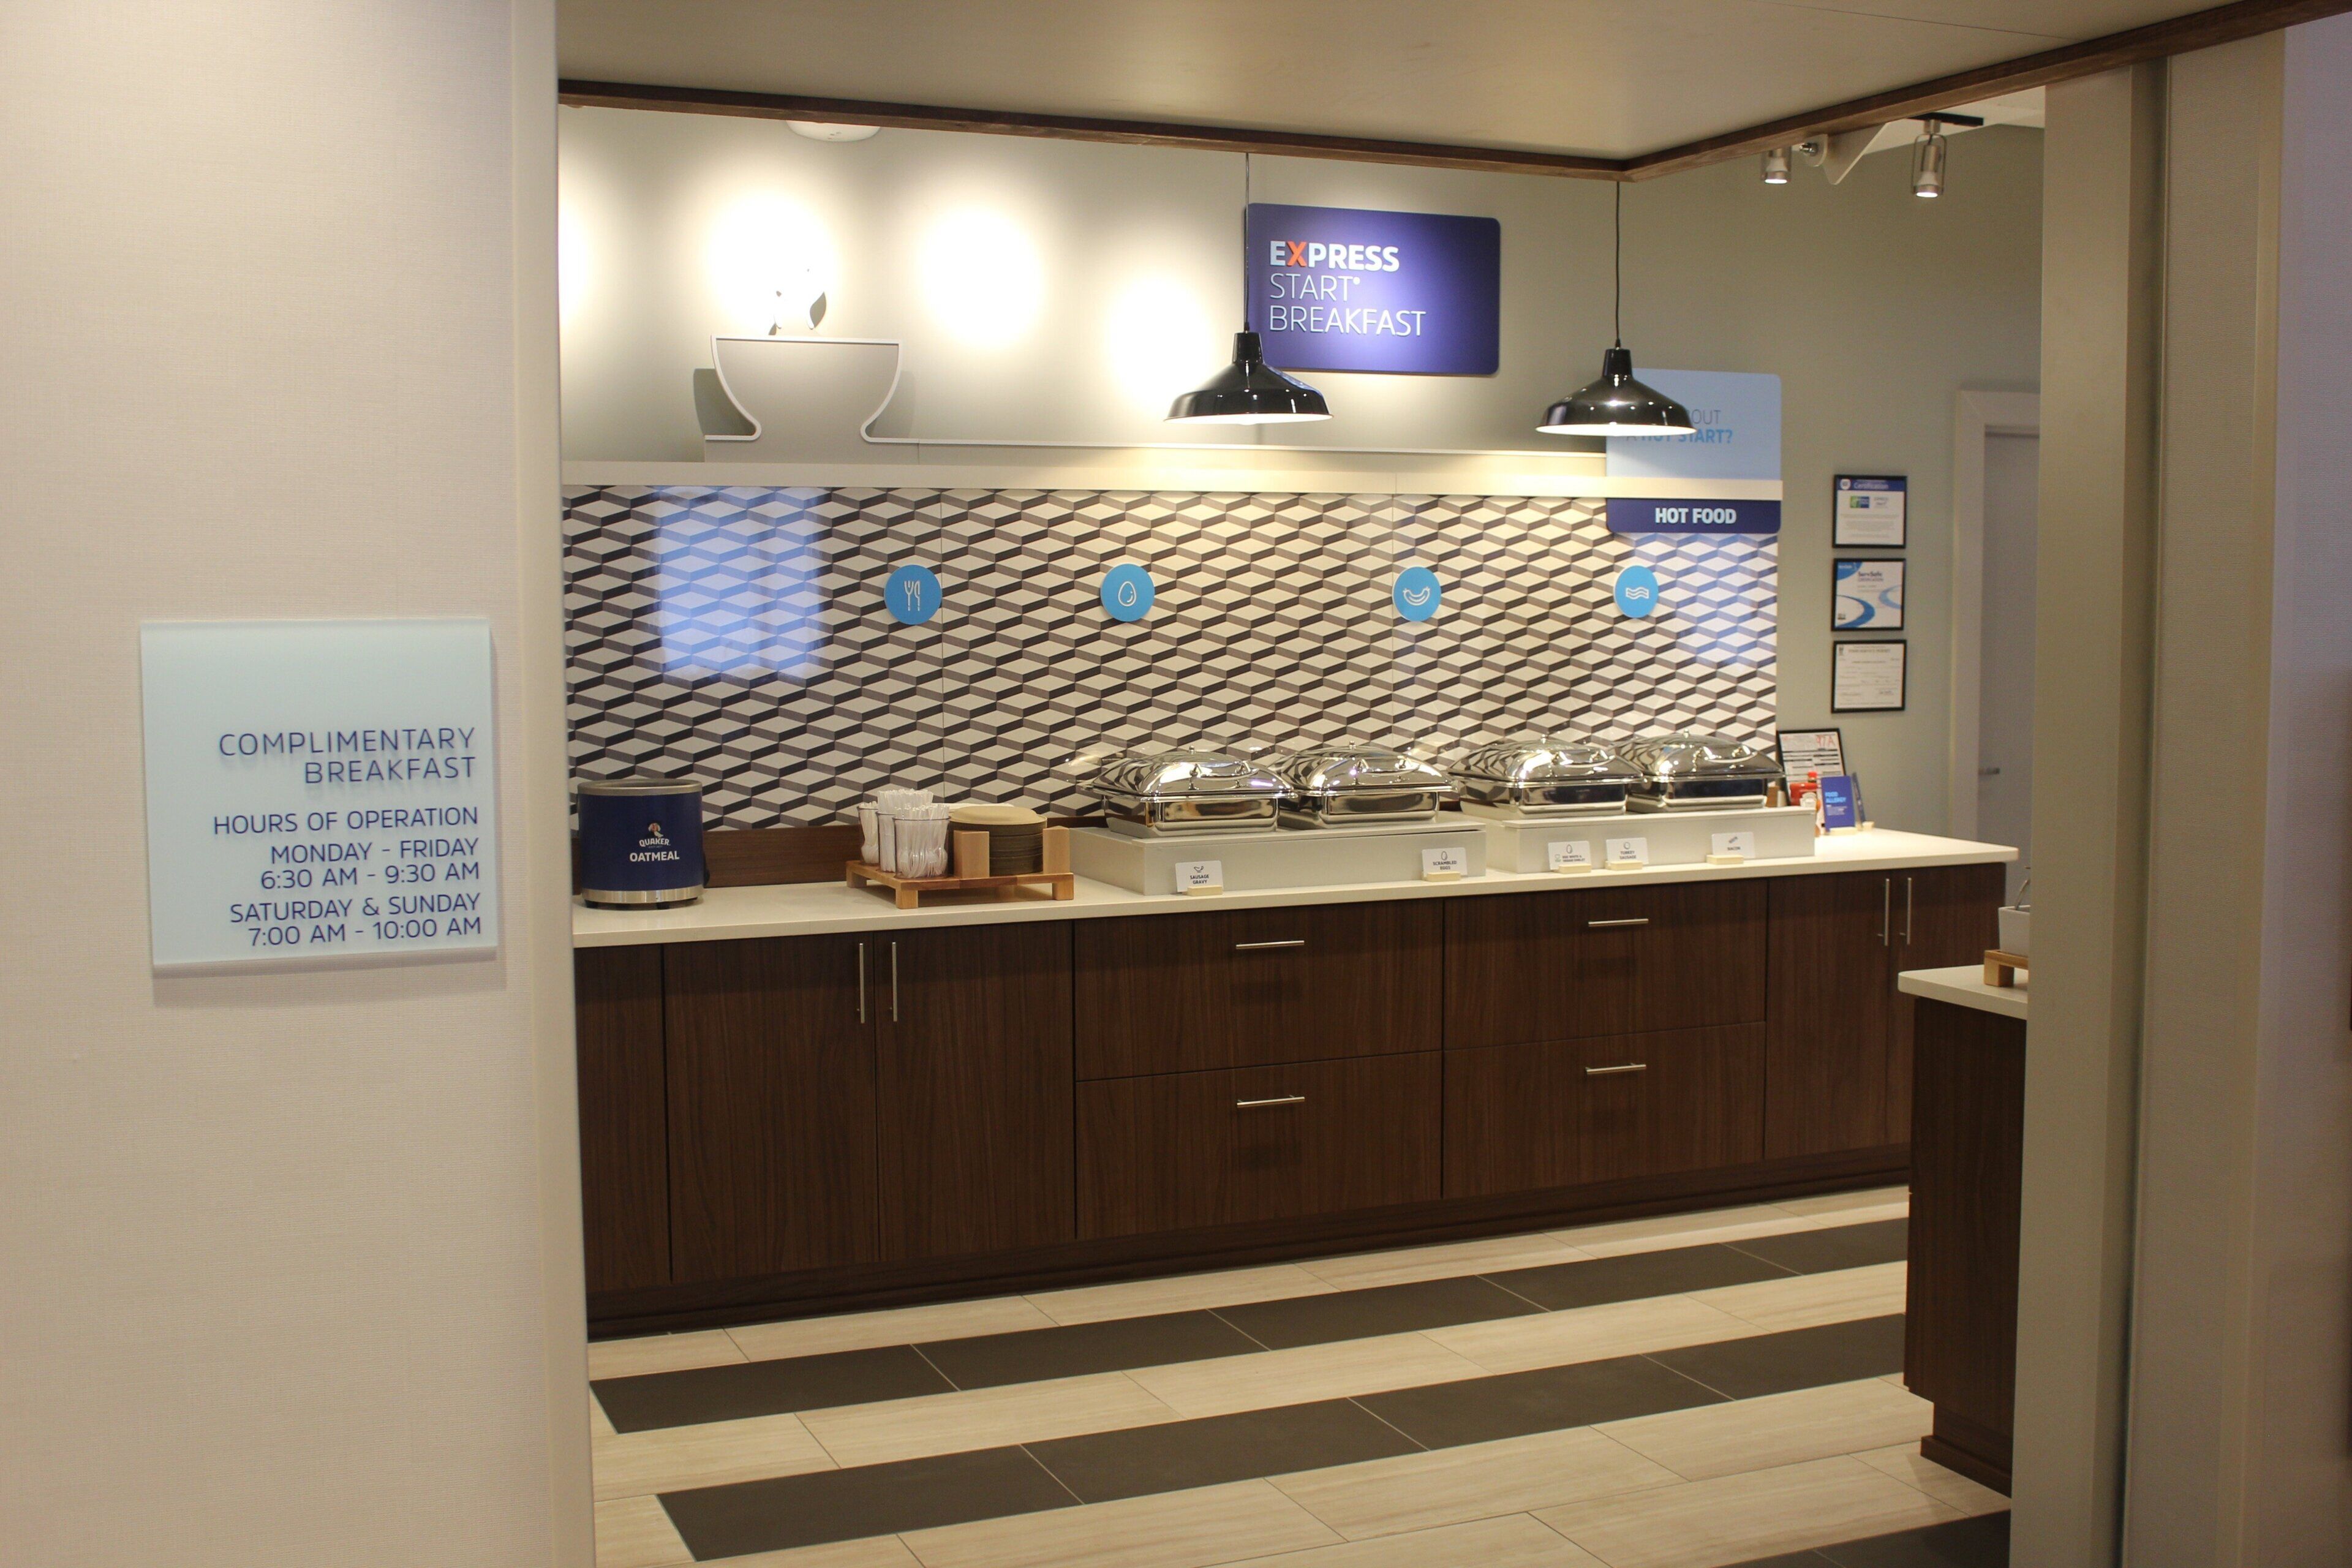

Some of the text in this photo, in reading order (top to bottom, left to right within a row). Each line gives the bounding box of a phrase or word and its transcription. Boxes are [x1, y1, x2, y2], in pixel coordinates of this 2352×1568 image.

[1270, 241, 1400, 273] EXPRESS
[1270, 304, 1427, 337] BREAKFAST
[1655, 508, 1737, 525] HOT FOOD
[219, 727, 475, 757] COMPLIMENTARY
[304, 756, 476, 785] BREAKFAST
[214, 807, 478, 835] HOURS OF OPERATION
[271, 842, 373, 865] MONDAY
[400, 837, 480, 859] FRIDAY
[629, 850, 680, 862] OATMEAL
[639, 838, 669, 847] QUAKER
[260, 869, 313, 889] 6:30
[322, 867, 358, 887] AM
[385, 864, 436, 884] 9:30
[444, 862, 480, 881] AM
[230, 892, 481, 924] SATURDAY & SUNDAY
[247, 926, 301, 947] 7:00
[309, 924, 346, 943] AM
[372, 919, 438, 940] 10:00
[446, 916, 481, 936] AM
